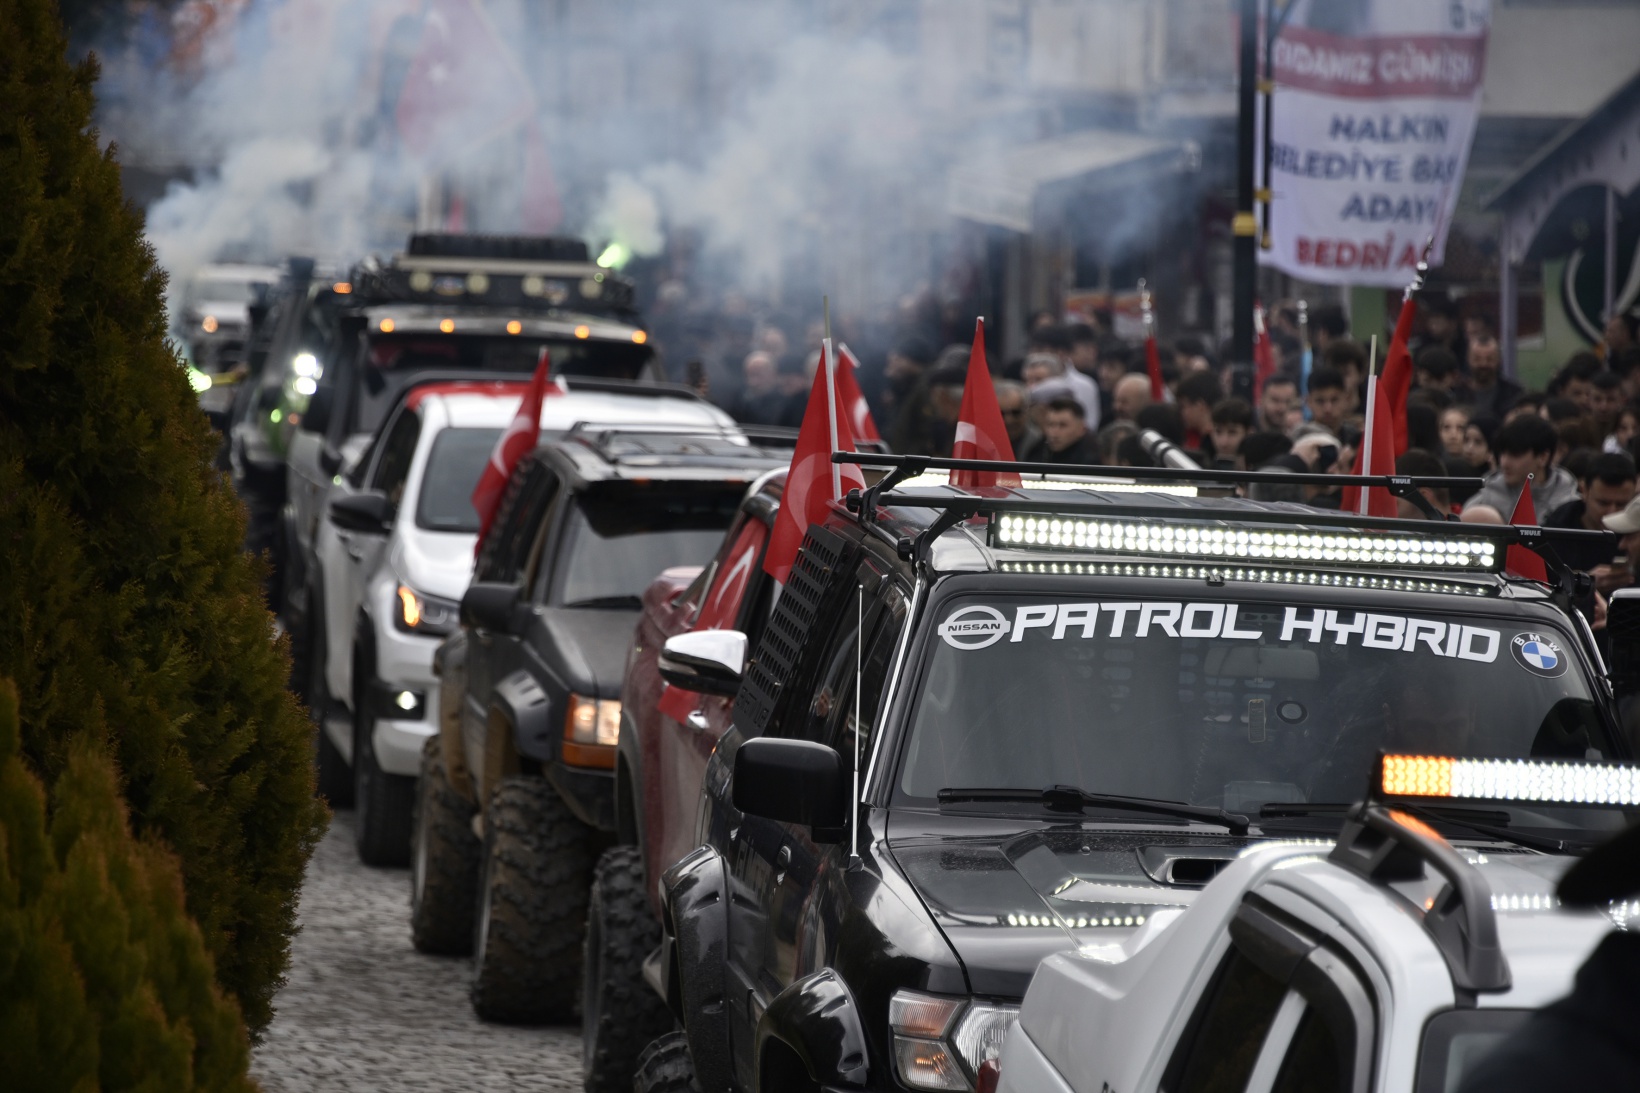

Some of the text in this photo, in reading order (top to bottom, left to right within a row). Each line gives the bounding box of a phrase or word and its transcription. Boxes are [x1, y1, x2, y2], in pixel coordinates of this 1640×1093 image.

[1330, 114, 1449, 143] HALKIN
[1296, 231, 1395, 271] BEDRİ
[1519, 529, 1542, 537] THULE
[947, 622, 1001, 632] NISSAN
[1010, 602, 1501, 664] PATROL HYBRID
[1513, 633, 1561, 653] BMW
